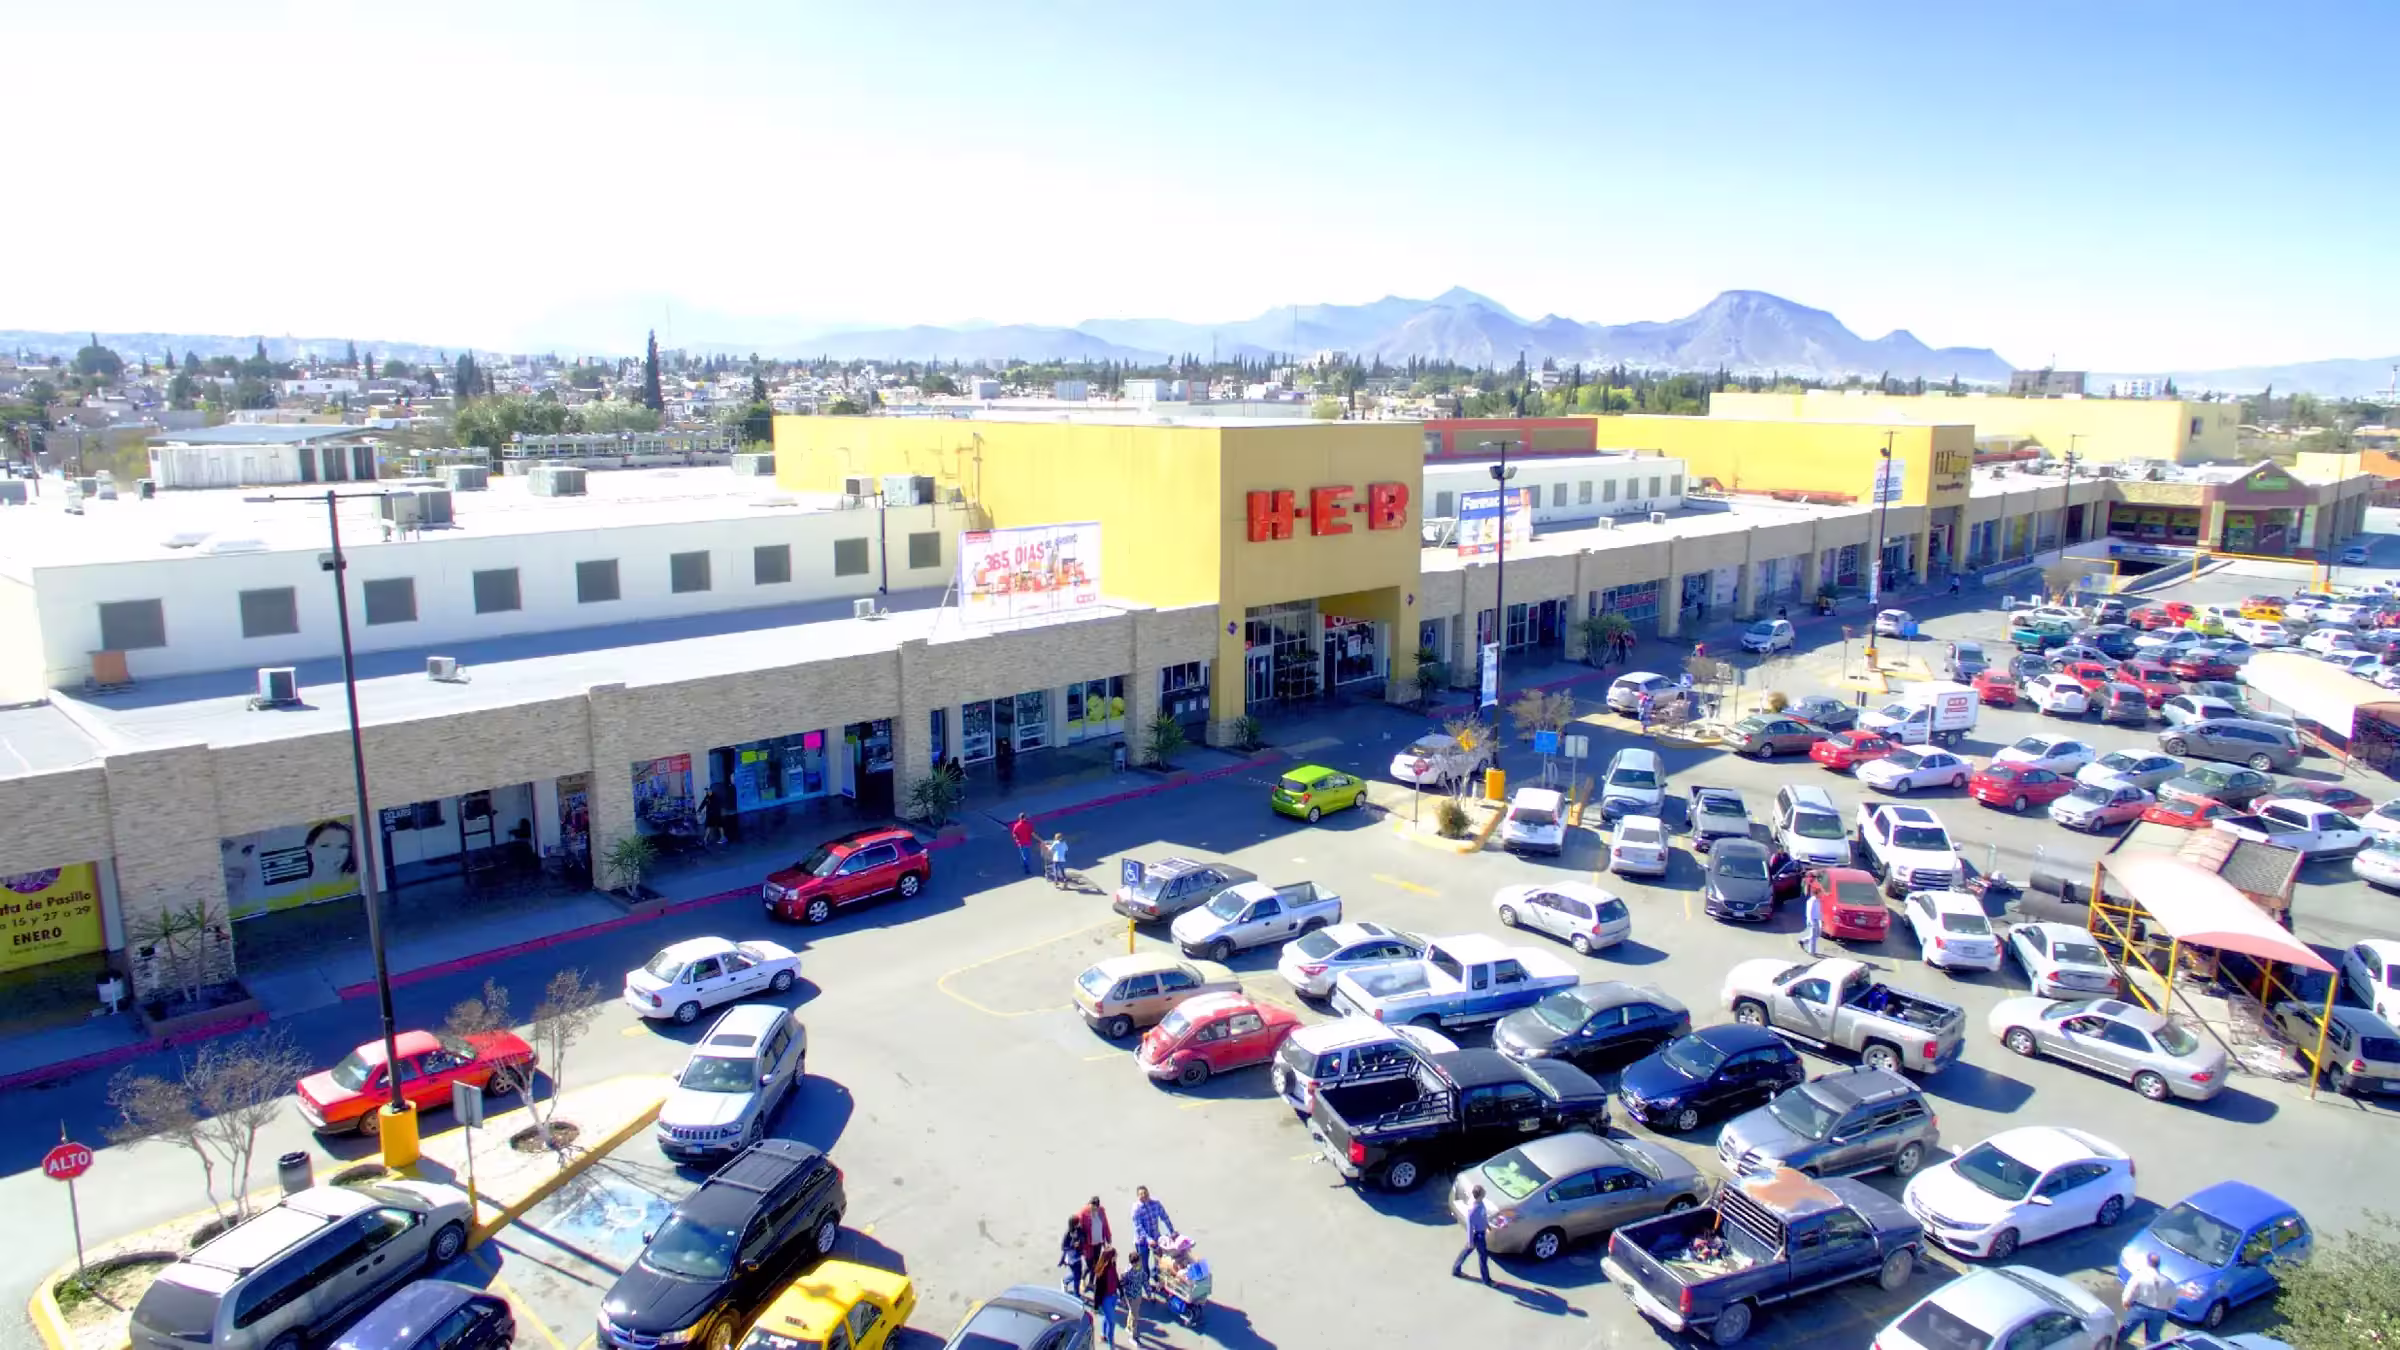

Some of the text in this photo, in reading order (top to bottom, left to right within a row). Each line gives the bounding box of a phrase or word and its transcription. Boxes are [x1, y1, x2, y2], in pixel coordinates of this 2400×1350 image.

[1247, 482, 1409, 542] H-E-B
[985, 550, 1010, 573] 365
[26, 900, 42, 911] de
[46, 890, 92, 907] Pasillo
[12, 917, 27, 927] 15
[31, 917, 39, 926] y
[42, 911, 58, 922] 27
[74, 905, 92, 915] 29
[13, 926, 63, 946] ENERO
[48, 1151, 90, 1174] ALTO
